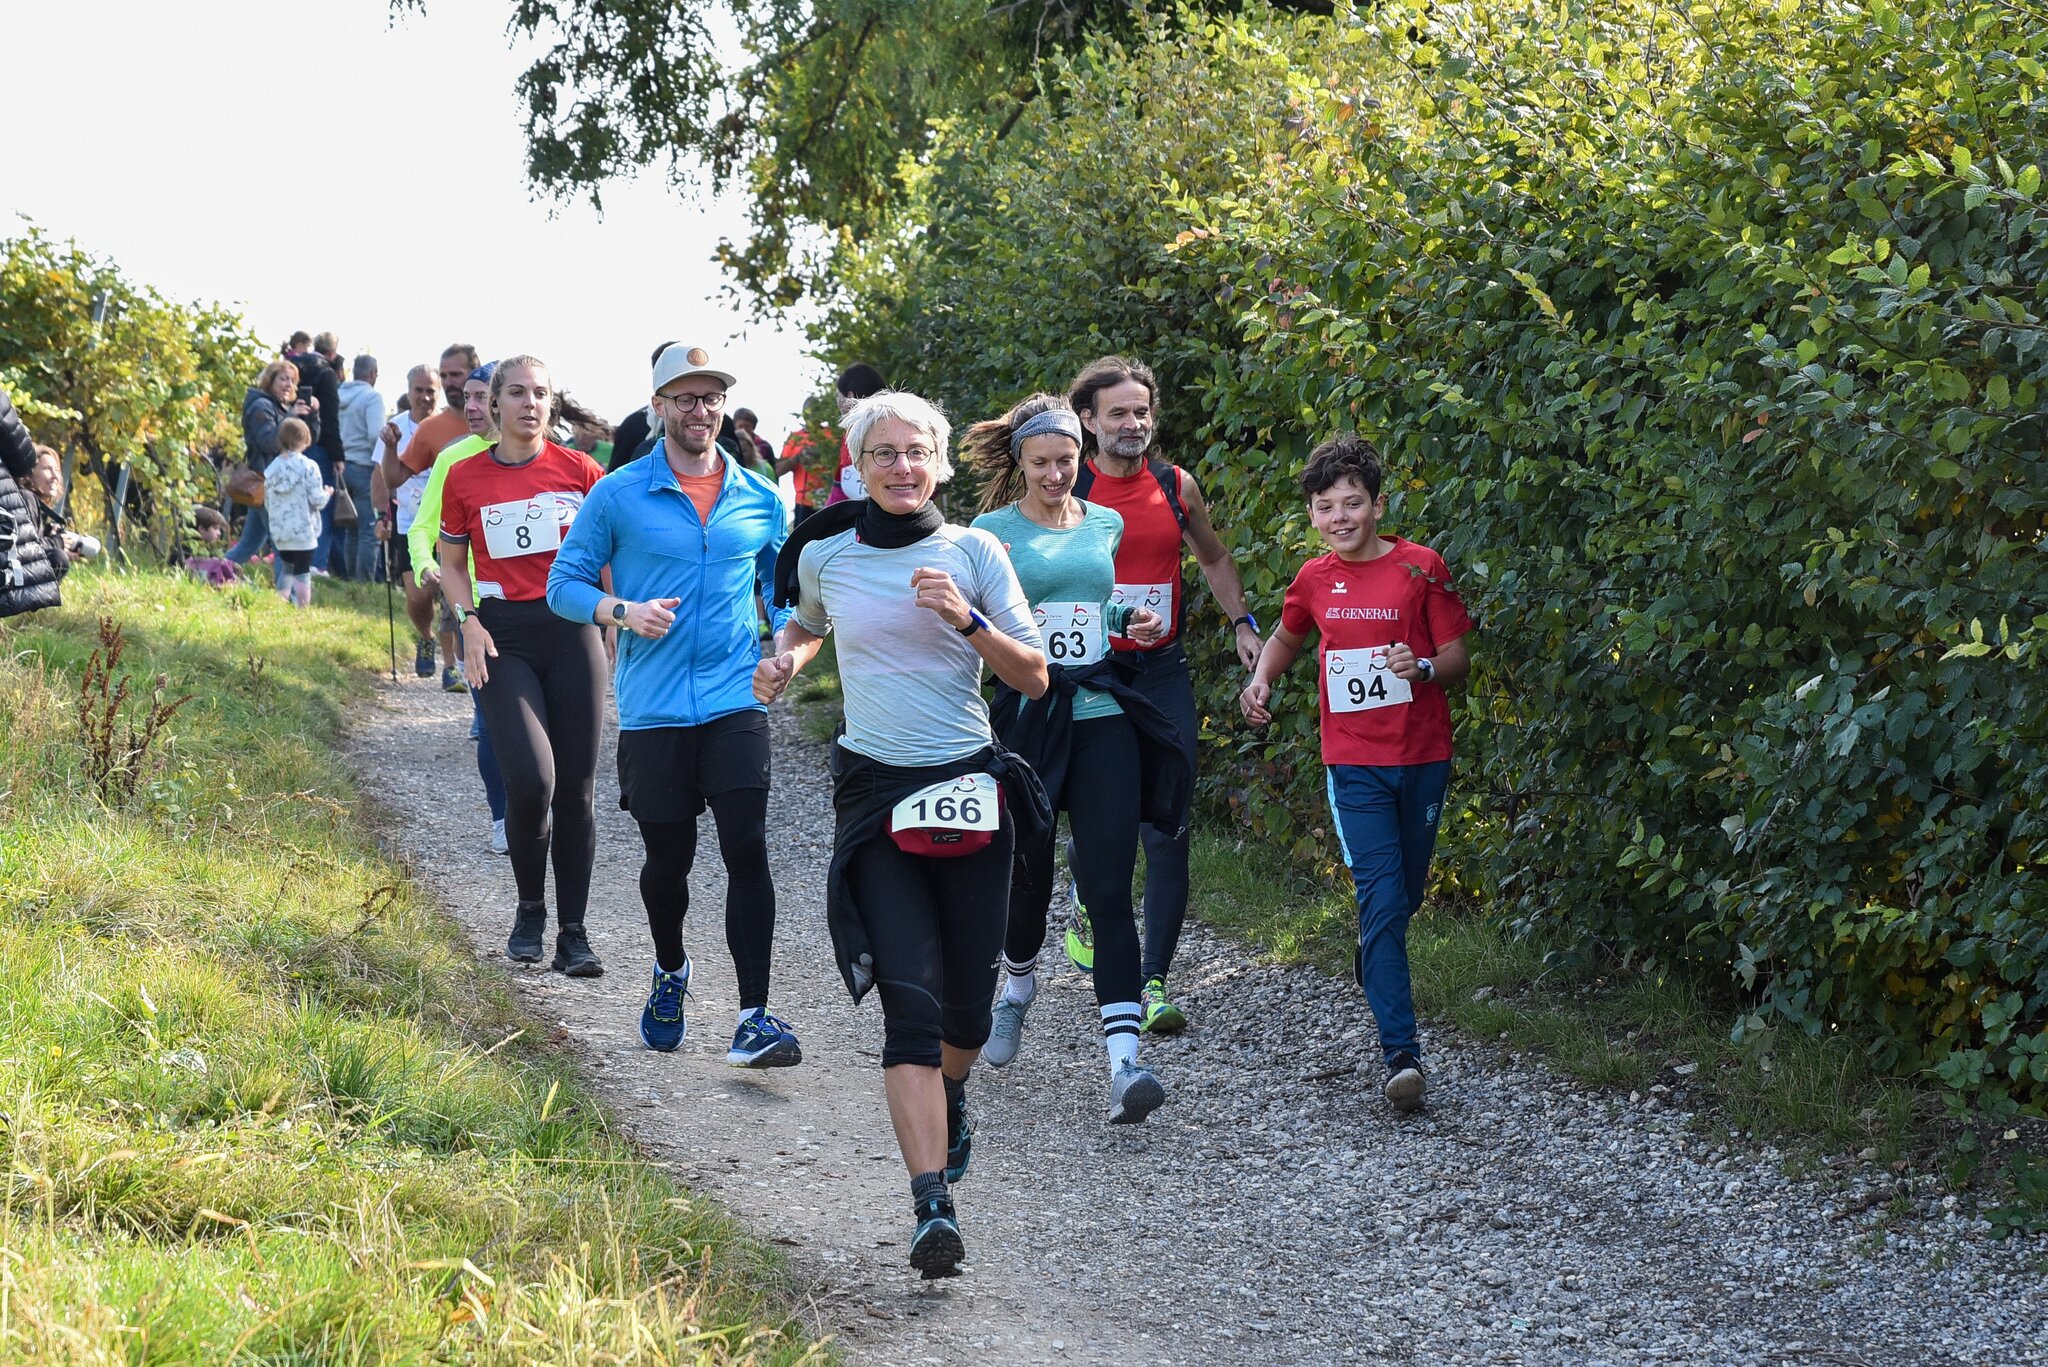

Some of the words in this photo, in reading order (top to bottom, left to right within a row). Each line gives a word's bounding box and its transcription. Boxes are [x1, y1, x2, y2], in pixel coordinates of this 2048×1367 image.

[515, 525, 532, 549] 8
[1341, 607, 1399, 620] GENERALI
[1048, 631, 1086, 659] 63
[1347, 674, 1388, 705] 94
[911, 796, 982, 824] 166
